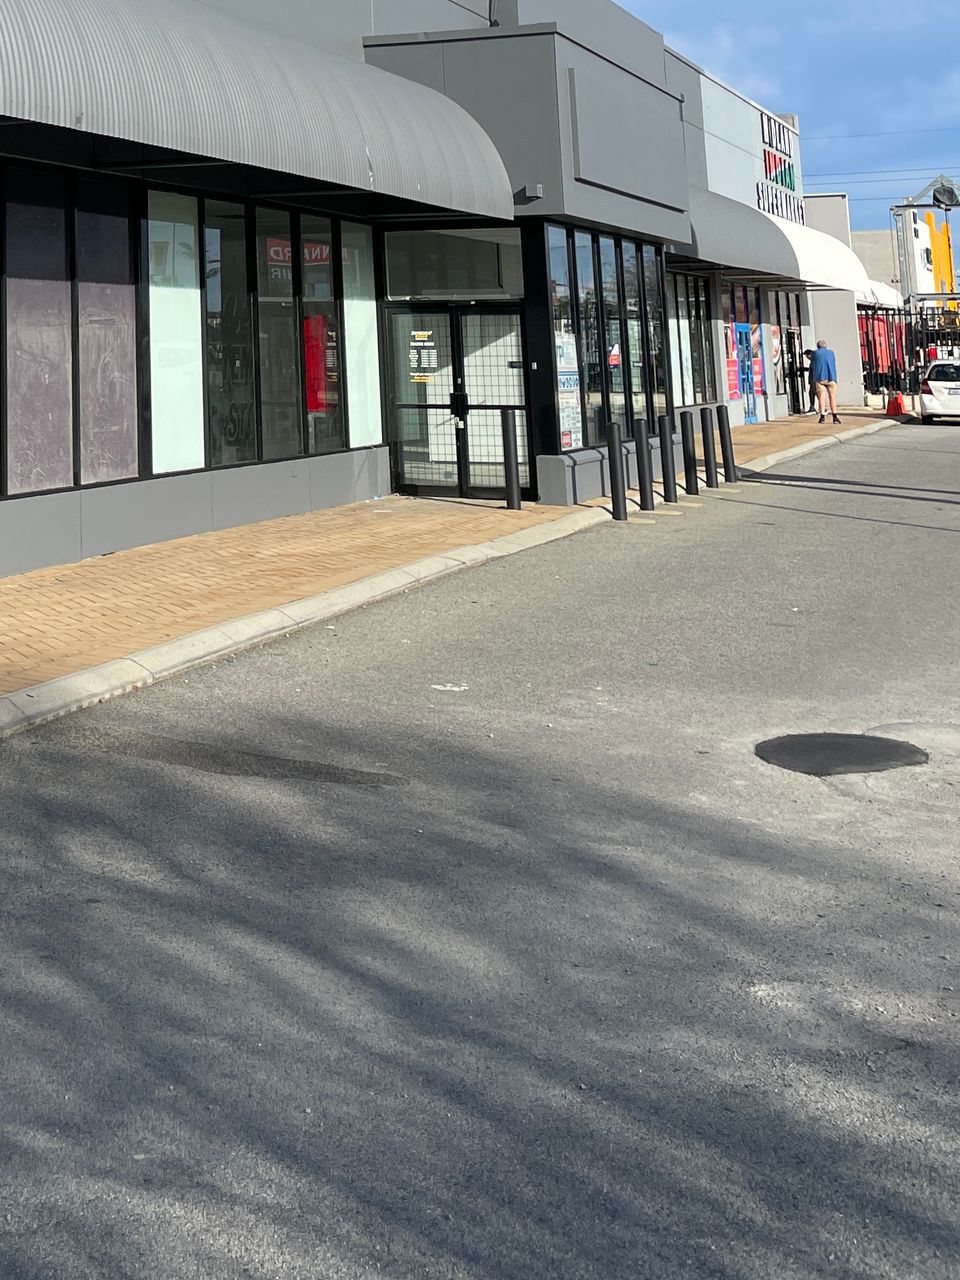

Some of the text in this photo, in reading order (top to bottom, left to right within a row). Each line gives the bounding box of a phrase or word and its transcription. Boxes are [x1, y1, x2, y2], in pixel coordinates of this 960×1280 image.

[760, 113, 793, 158] MIDLAND
[763, 149, 795, 192] INDIAN
[756, 180, 806, 227] SUPERMARKET
